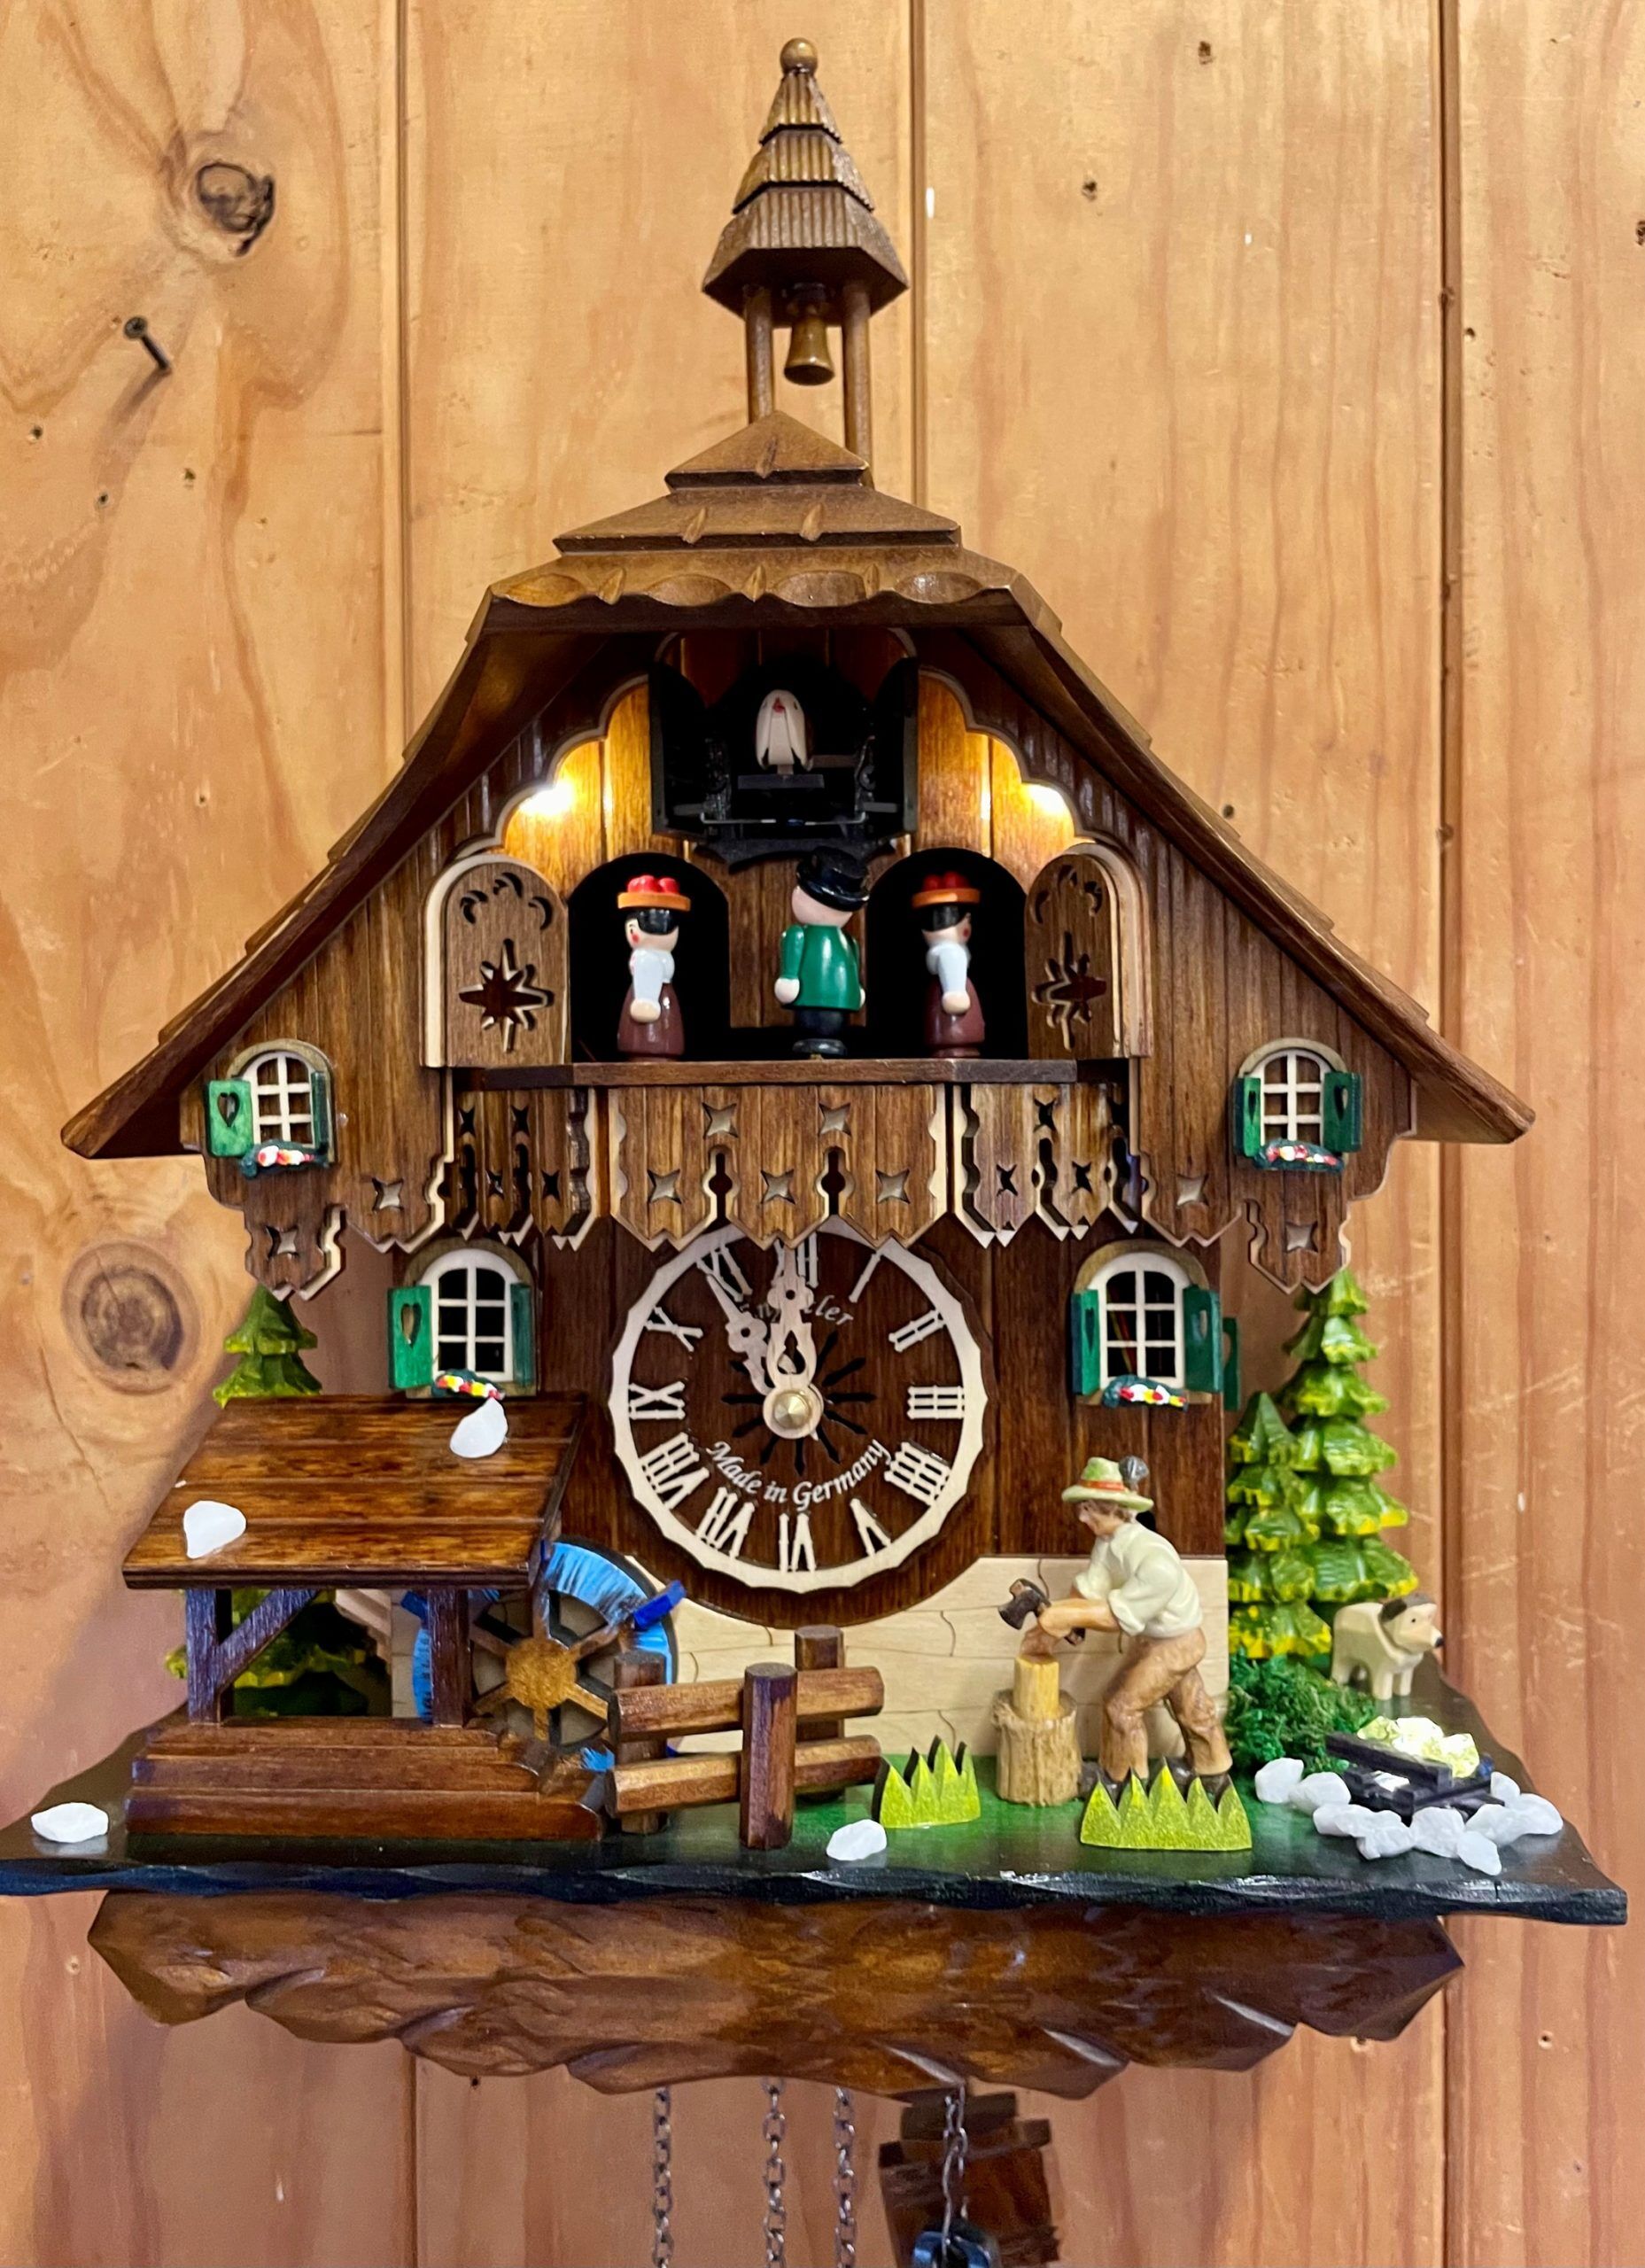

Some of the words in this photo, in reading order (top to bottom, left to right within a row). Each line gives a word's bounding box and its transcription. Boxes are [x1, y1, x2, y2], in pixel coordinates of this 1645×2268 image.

[644, 1307, 704, 1353] X
[888, 1309, 946, 1354] II
[628, 1380, 687, 1420] IX
[906, 1385, 965, 1419] III
[638, 1432, 710, 1510] VIII
[706, 1441, 763, 1495] Made
[763, 1480, 788, 1504] in
[792, 1438, 892, 1511] Germany
[695, 1486, 756, 1560] VII
[779, 1512, 817, 1573] VI
[850, 1497, 892, 1557] V
